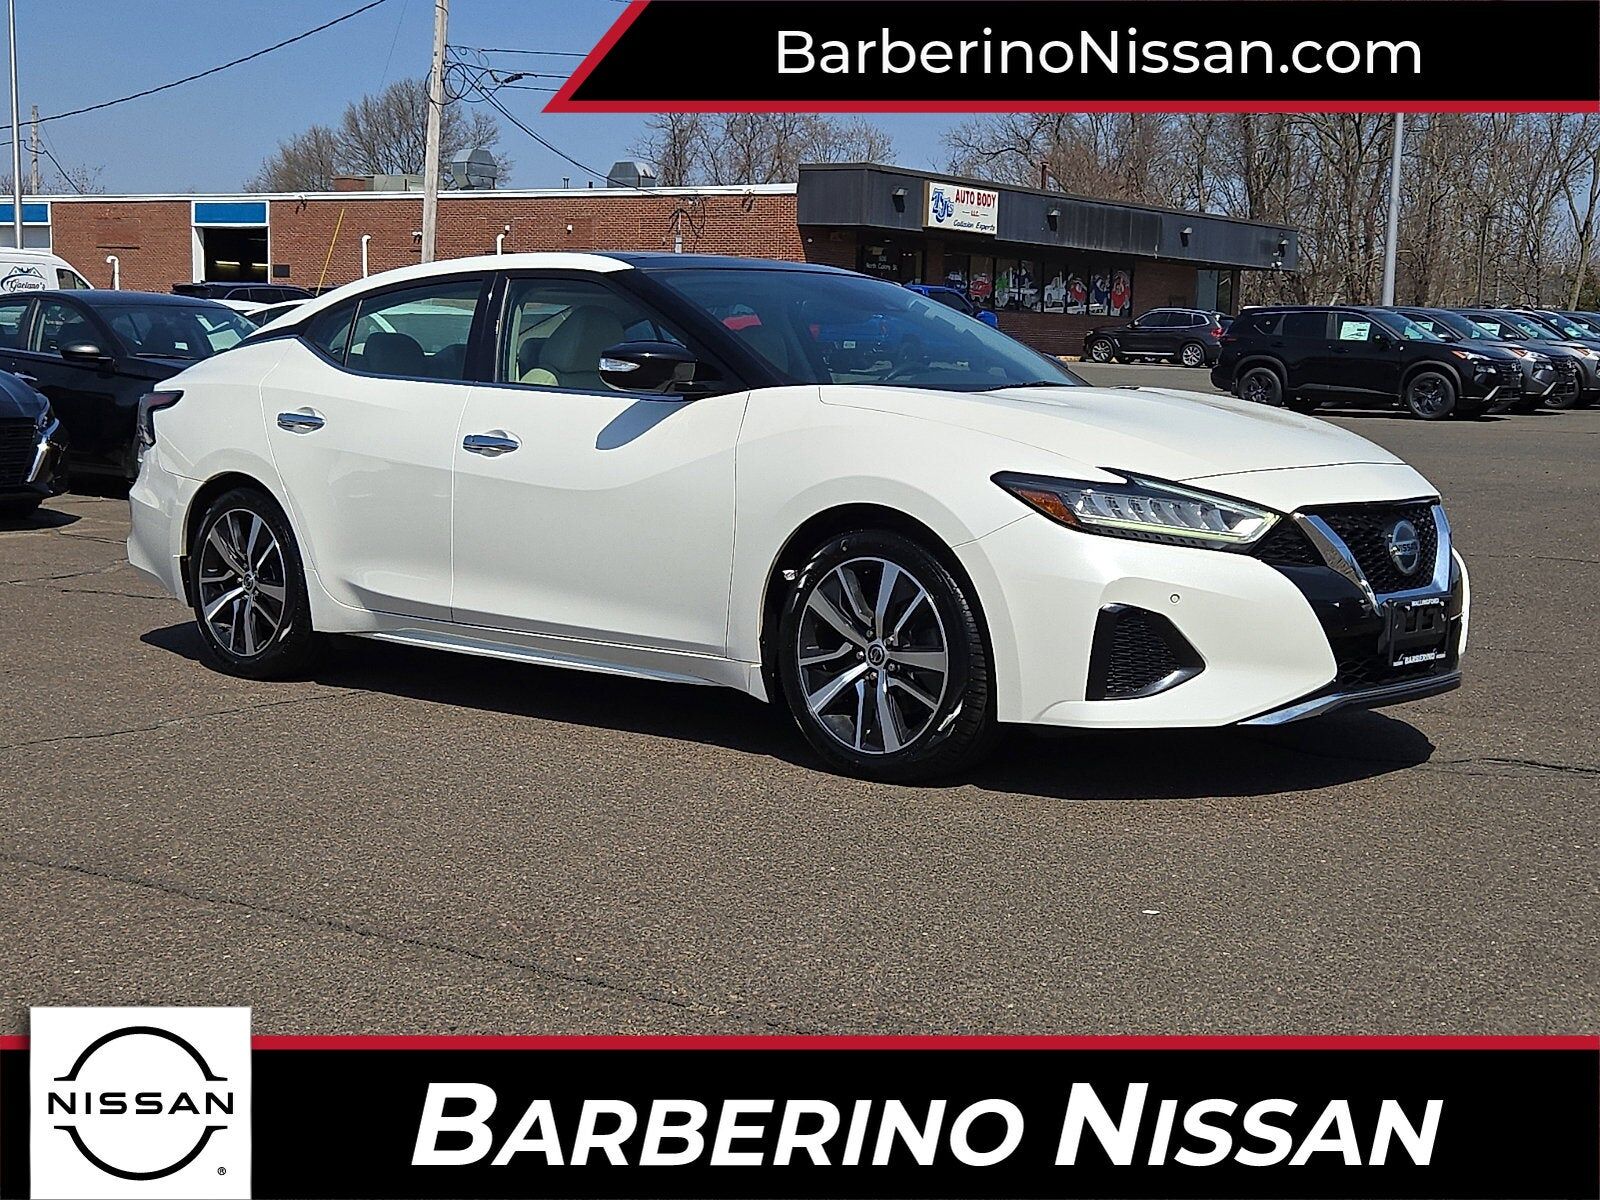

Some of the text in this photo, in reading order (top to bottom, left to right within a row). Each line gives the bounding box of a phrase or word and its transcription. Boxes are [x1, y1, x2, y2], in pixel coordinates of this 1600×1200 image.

[955, 189, 997, 208] AUTO BODY
[975, 221, 996, 231] Experts
